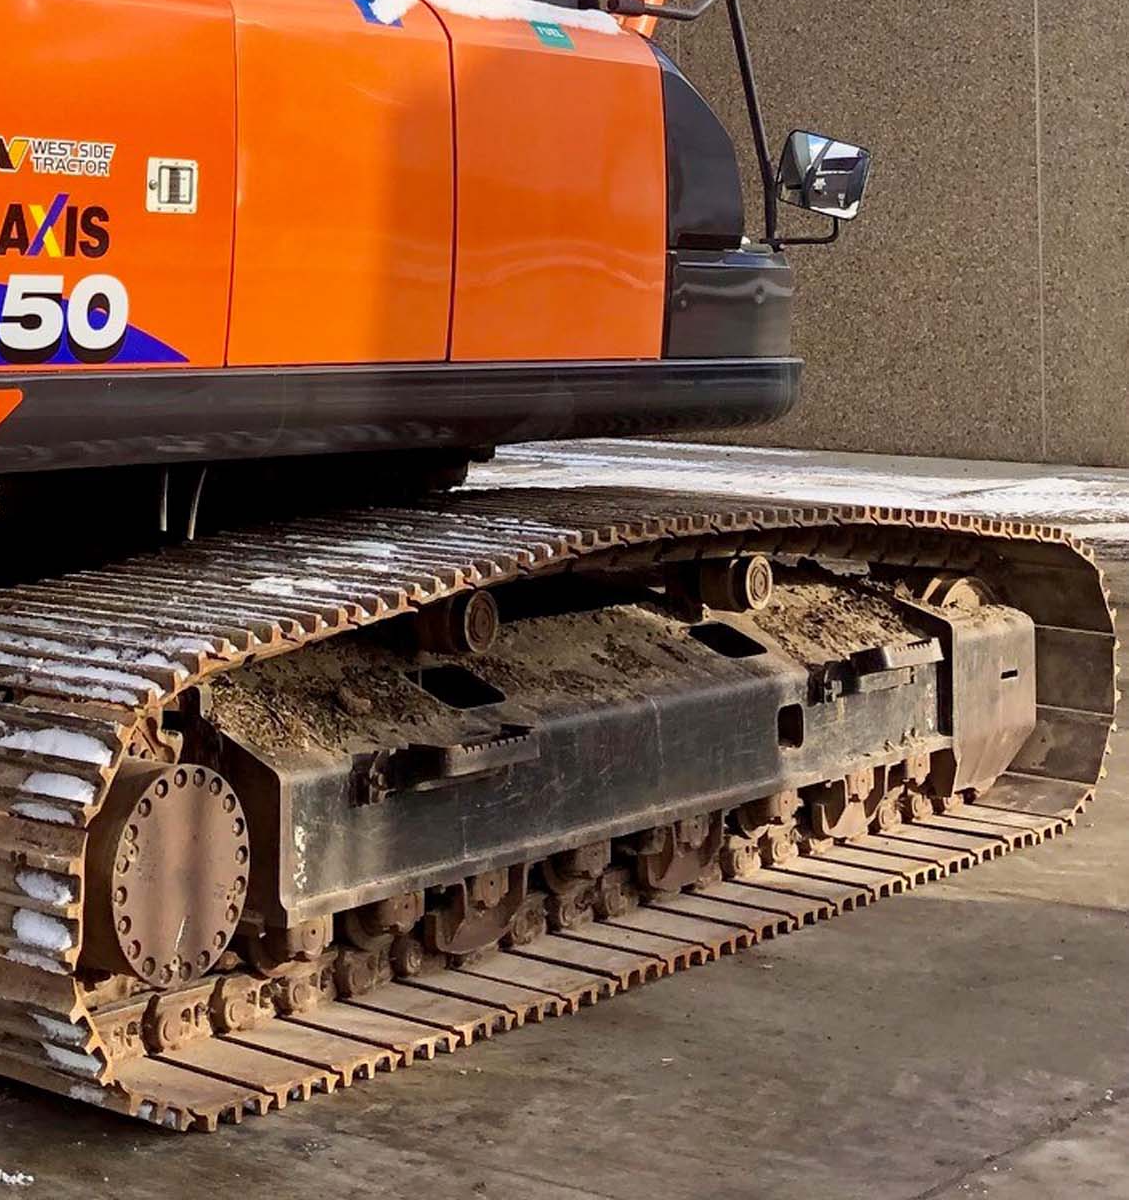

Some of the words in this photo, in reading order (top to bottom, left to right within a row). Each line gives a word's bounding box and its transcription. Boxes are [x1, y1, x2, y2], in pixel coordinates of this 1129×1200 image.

[536, 26, 565, 38] FUEL
[31, 140, 76, 157] WEST
[80, 145, 114, 159] SIDE
[32, 157, 110, 175] TRACTOR
